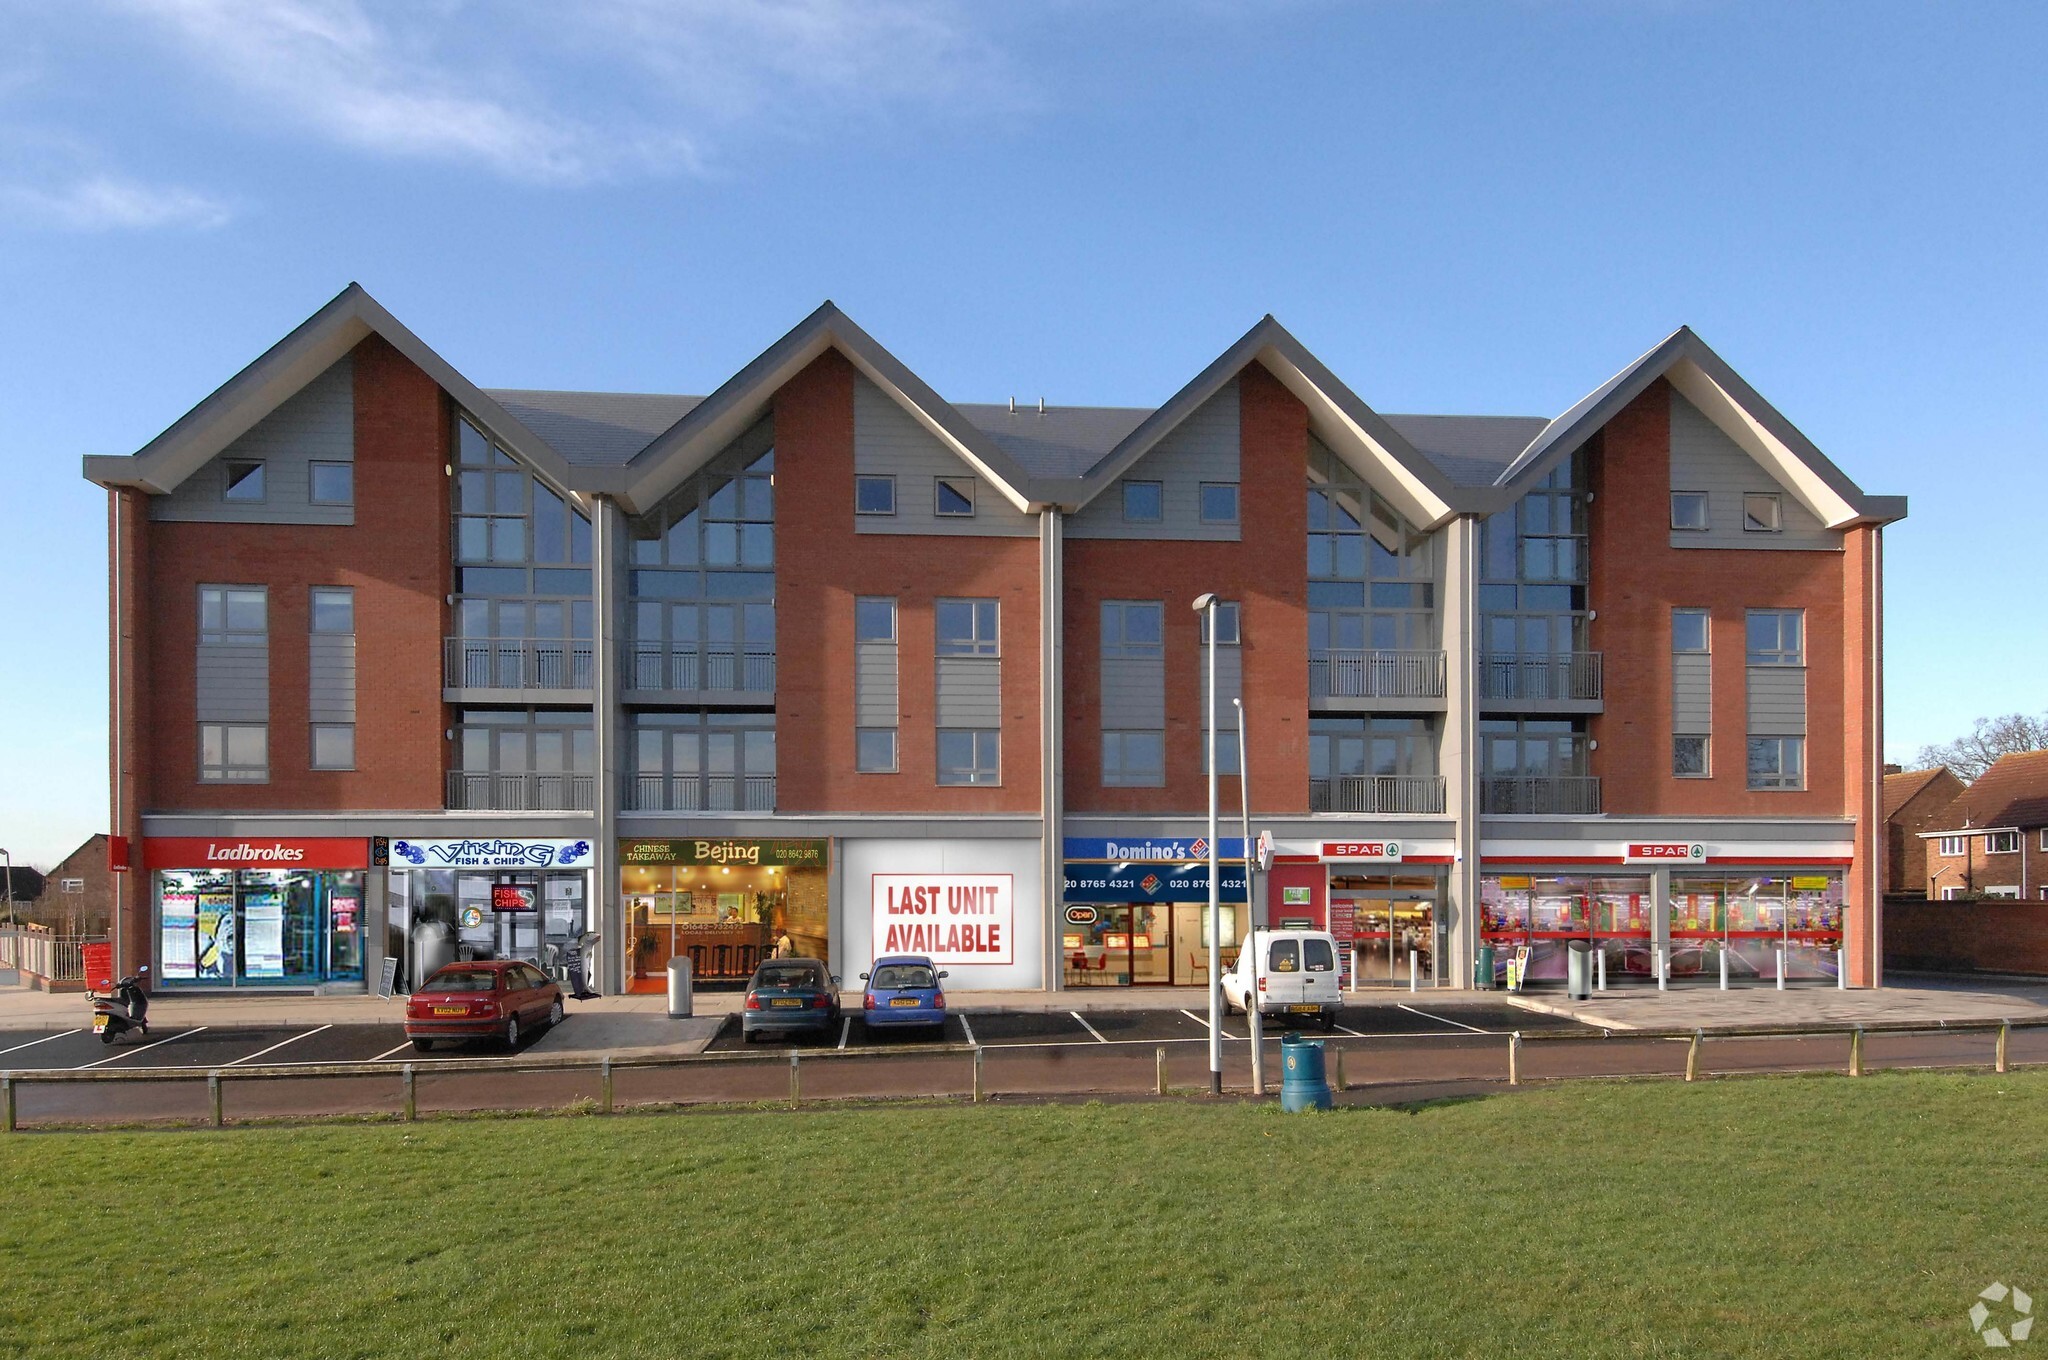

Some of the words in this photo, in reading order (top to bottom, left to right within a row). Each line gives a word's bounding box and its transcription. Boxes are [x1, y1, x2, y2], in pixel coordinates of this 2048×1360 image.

[207, 843, 304, 861] Ladbrokes
[633, 845, 671, 853] CHINESE
[694, 841, 761, 865] Bejing
[776, 849, 788, 859] 020
[788, 849, 803, 859] 8642
[804, 849, 818, 859] 9876
[1106, 841, 1186, 860] Domino's
[1336, 845, 1382, 855] SPAR
[1641, 846, 1687, 856] SPAR
[455, 857, 479, 865] FISH
[483, 857, 490, 865] &
[494, 857, 525, 865] CHIPS
[626, 853, 677, 861] TAKEAWAY
[1080, 879, 1106, 888] 8765
[1109, 879, 1135, 888] 4321
[1169, 879, 1189, 888] 020
[1192, 879, 1210, 888] 876
[1221, 879, 1247, 888] 4321
[494, 889, 518, 899] FISH
[494, 899, 525, 908] CHIPS
[887, 886, 940, 915] LAST
[947, 886, 999, 915] UNIT
[1070, 910, 1093, 920] Open
[885, 924, 1001, 953] AVAILABLE
